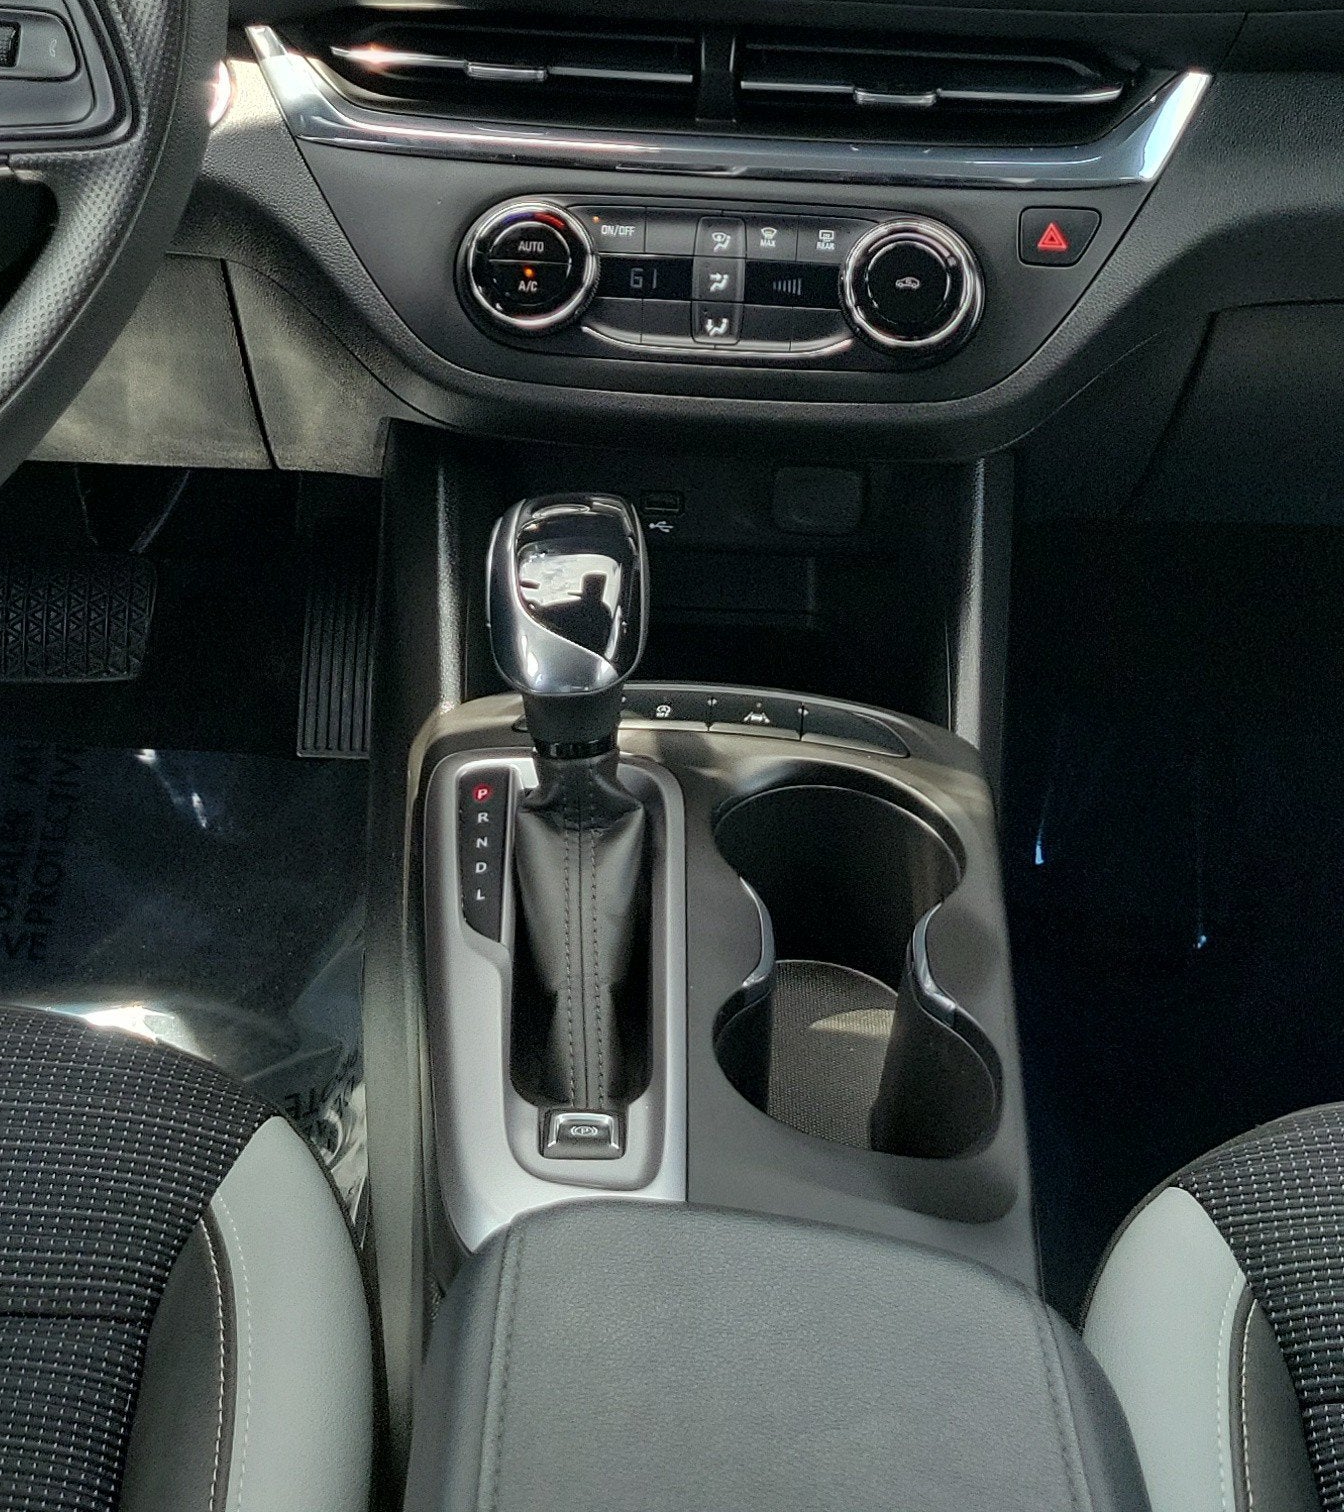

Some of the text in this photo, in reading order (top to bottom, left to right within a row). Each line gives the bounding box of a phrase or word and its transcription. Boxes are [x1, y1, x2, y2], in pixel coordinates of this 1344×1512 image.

[600, 224, 636, 237] ON/OFF
[518, 240, 544, 253] AUTO
[518, 279, 538, 293] A/C
[477, 788, 488, 800] P
[477, 811, 489, 823] R
[476, 836, 488, 848] N
[475, 861, 487, 873] D
[476, 889, 485, 900] L
